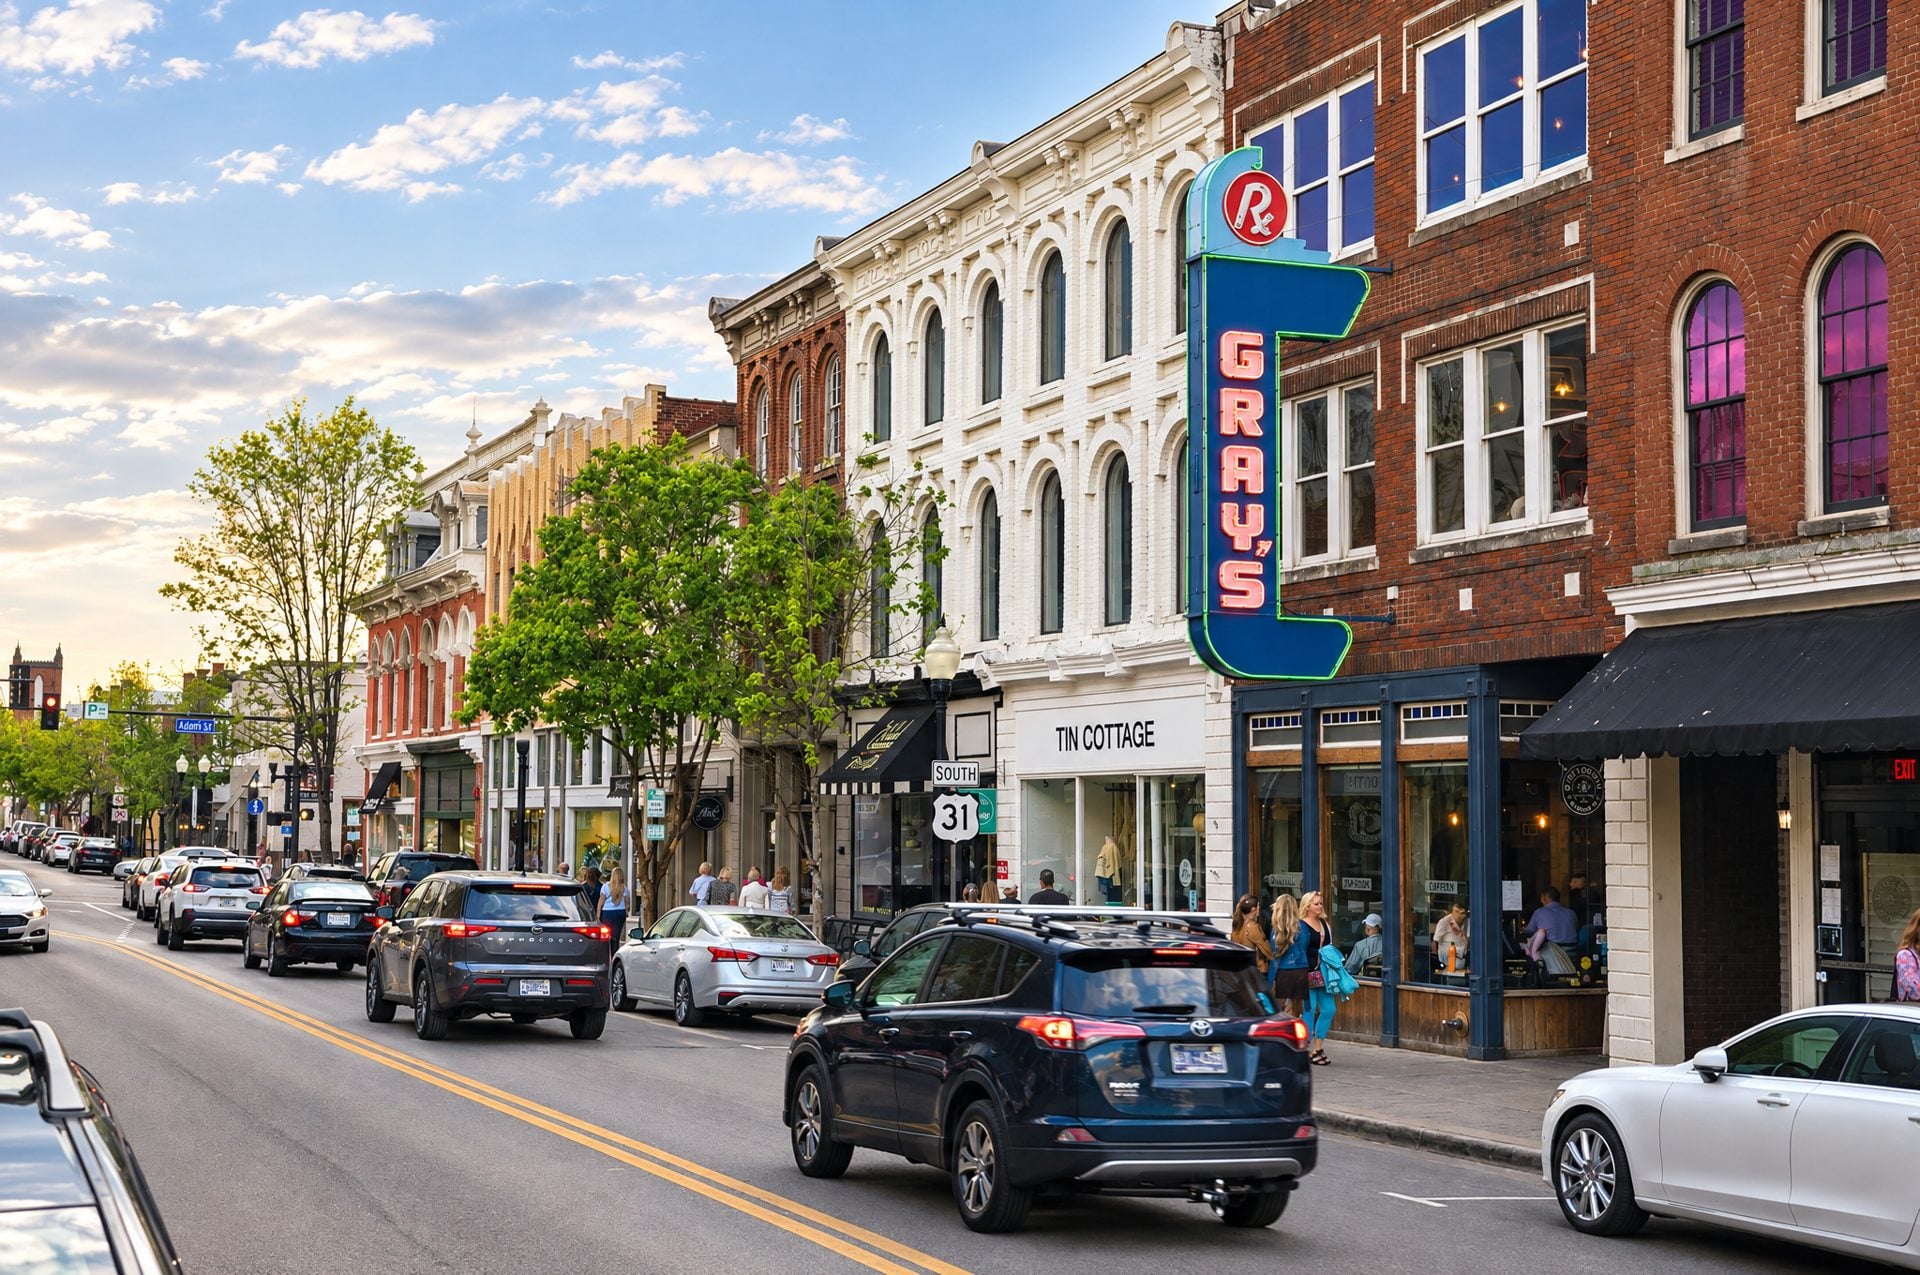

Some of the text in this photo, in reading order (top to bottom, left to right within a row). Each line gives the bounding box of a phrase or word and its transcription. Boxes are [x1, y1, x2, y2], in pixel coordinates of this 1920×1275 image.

[1219, 330, 1272, 608] GRAY'S
[1056, 720, 1155, 751] TIN COTTAGE
[936, 765, 976, 781] SOUTH
[1894, 759, 1916, 779] EXIT
[941, 803, 968, 831] 31
